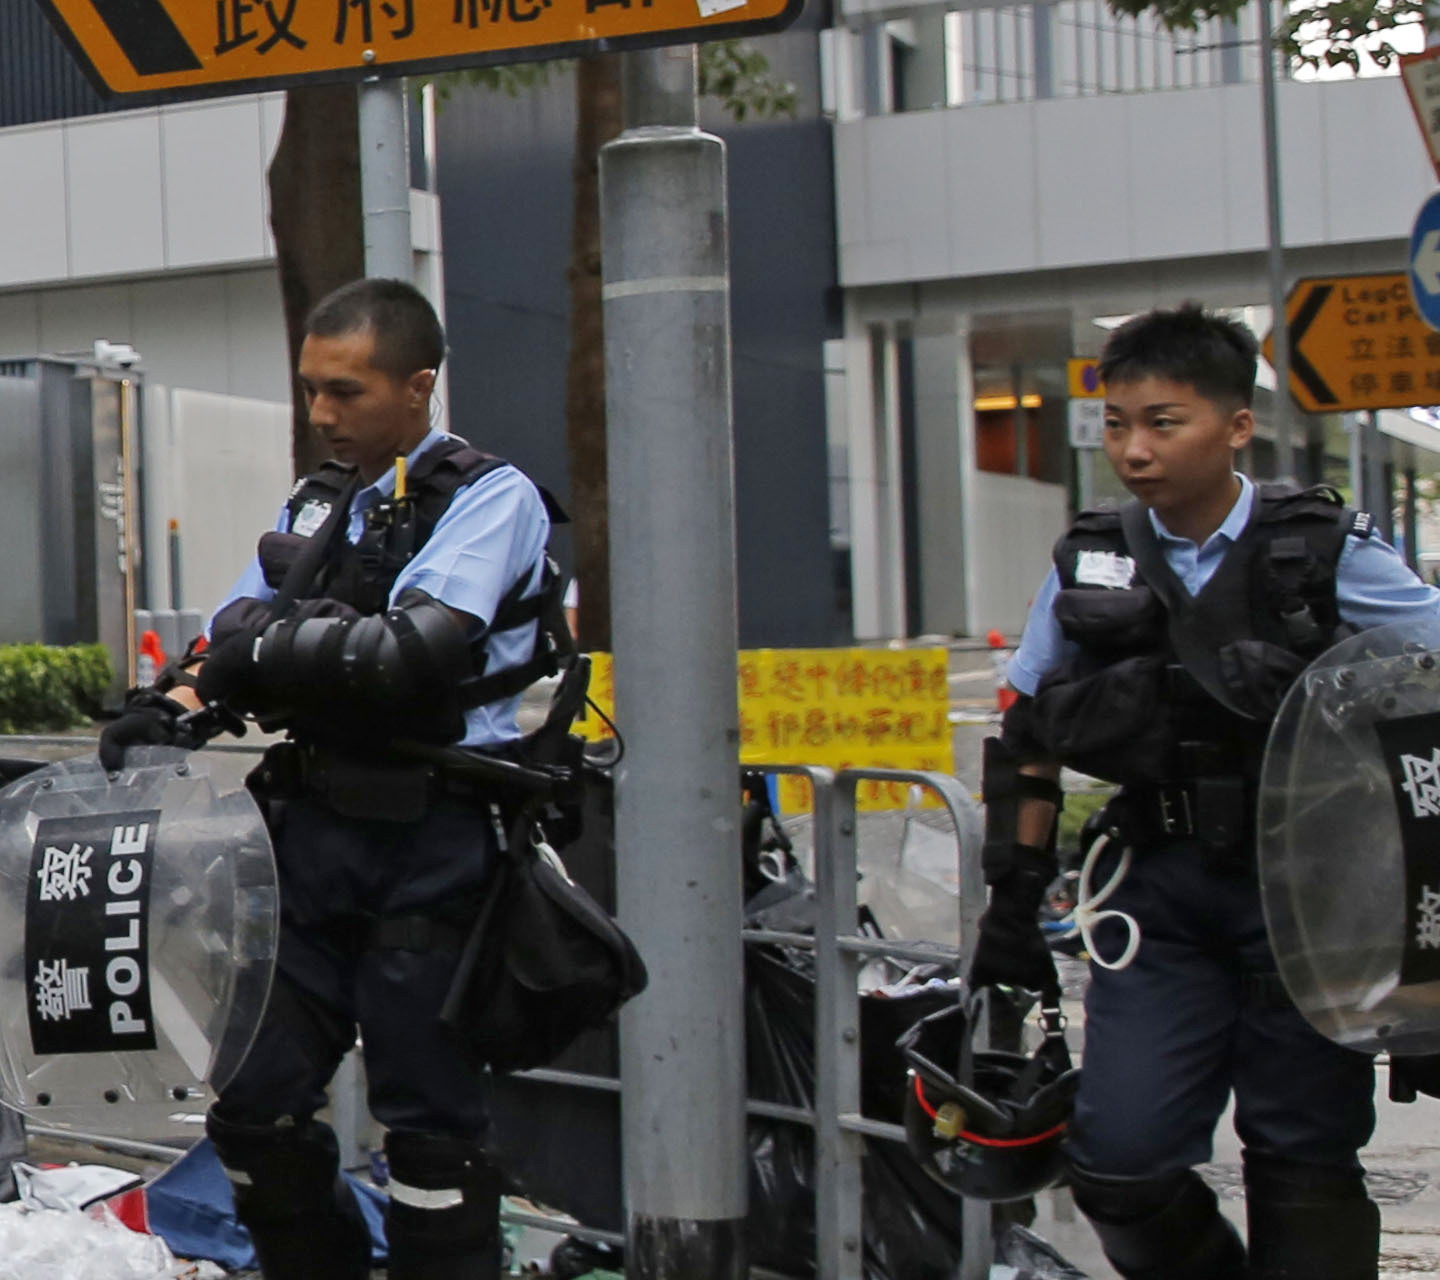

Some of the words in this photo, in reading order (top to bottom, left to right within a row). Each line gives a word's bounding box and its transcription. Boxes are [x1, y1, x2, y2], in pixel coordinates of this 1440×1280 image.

[1342, 283, 1408, 306] LegC
[1344, 306, 1390, 327] Car
[34, 842, 95, 1022] 警察
[105, 821, 150, 1035] POLICE
